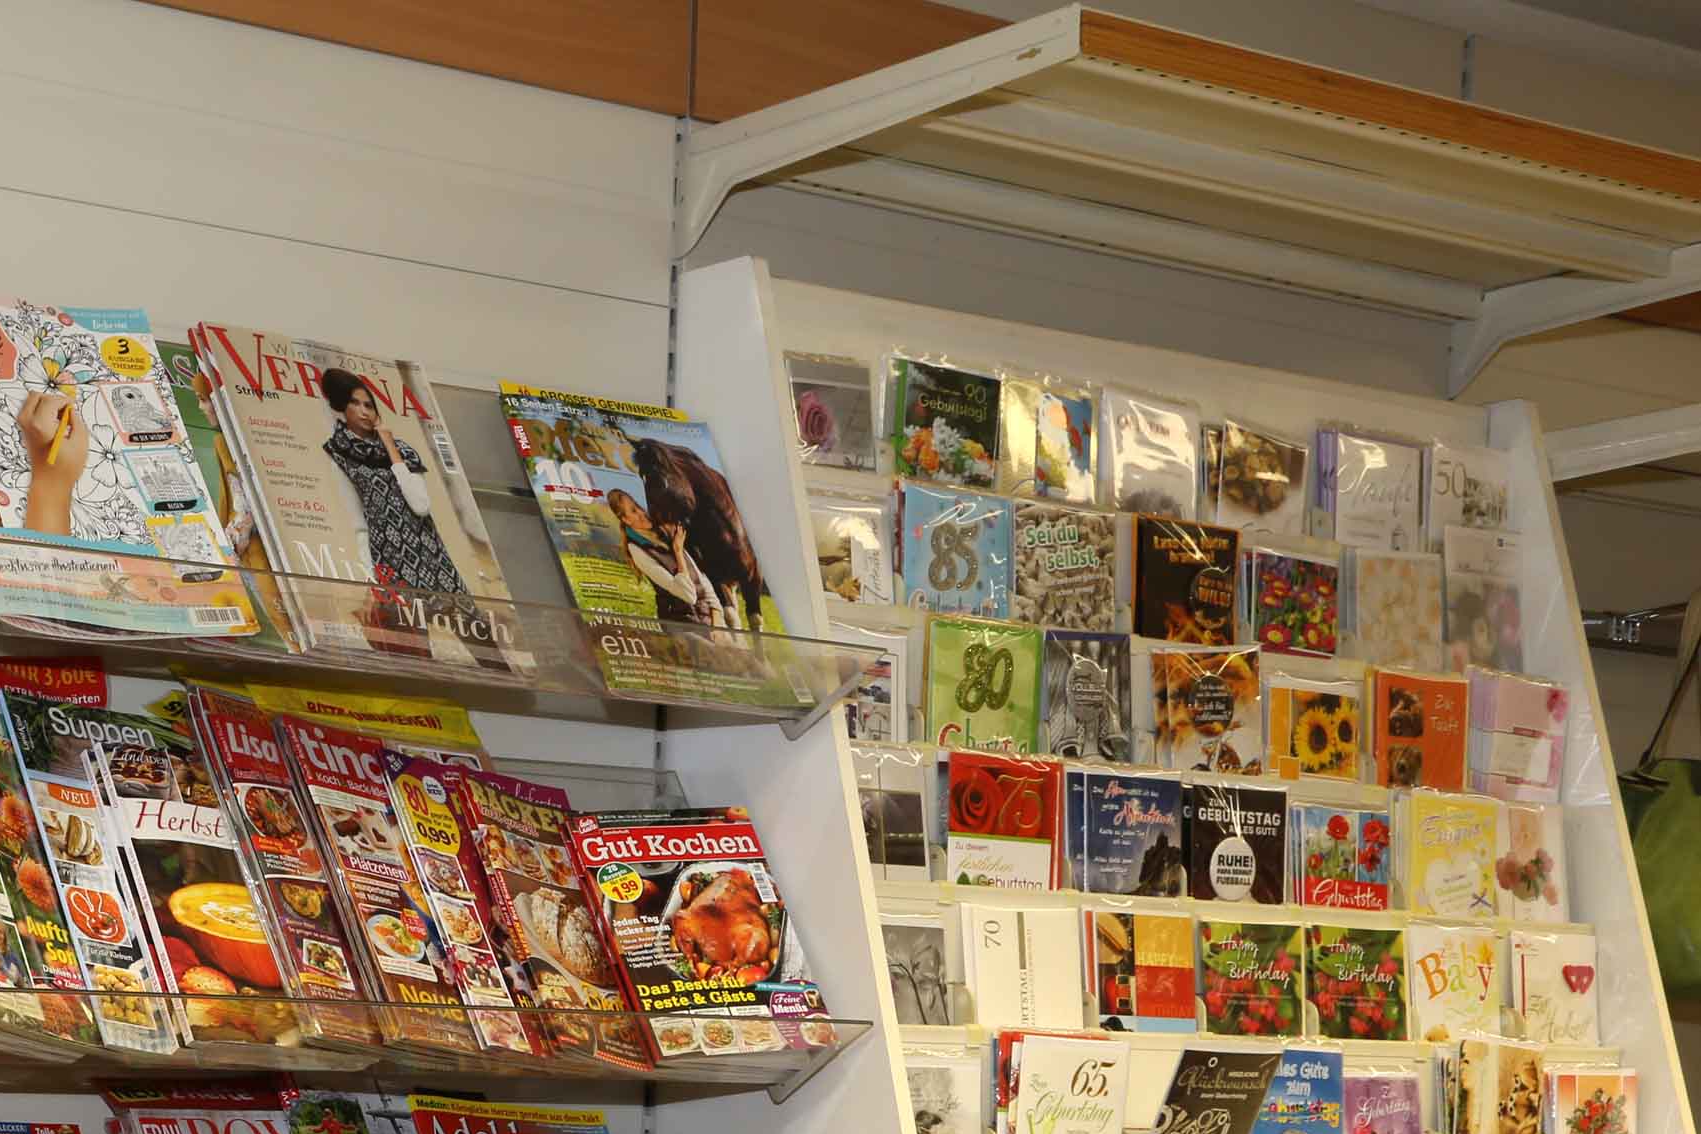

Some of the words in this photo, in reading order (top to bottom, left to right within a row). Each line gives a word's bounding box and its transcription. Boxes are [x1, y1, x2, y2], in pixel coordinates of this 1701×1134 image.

[118, 339, 129, 354] 3
[1026, 526, 1051, 547] Sei
[1053, 528, 1078, 543] du
[928, 524, 979, 591] 85
[1046, 547, 1099, 571] selbst,
[397, 597, 515, 644] Match
[601, 632, 650, 658] ein
[955, 643, 1013, 712] 80
[49, 709, 155, 747] Suppen
[227, 723, 279, 764] Lisa
[58, 789, 92, 808] NEU
[996, 772, 1044, 829] 75
[136, 800, 227, 839] Herbst
[582, 837, 643, 861] Gut
[643, 833, 758, 857] Kochen
[348, 854, 408, 883] Plätzchen
[1218, 856, 1254, 869] RUHE!
[1220, 936, 1259, 955] Happy
[1330, 936, 1363, 955] Happy
[1229, 960, 1289, 987] Birthday
[1337, 960, 1394, 987] Birthday
[1417, 943, 1494, 1000] Baby
[636, 983, 670, 996] Das
[673, 979, 718, 992] Beste
[721, 977, 746, 989] für
[642, 996, 689, 1011] Feste
[695, 994, 708, 1005] &
[712, 990, 755, 1005] Gäste
[1071, 1058, 1117, 1099] 65.
